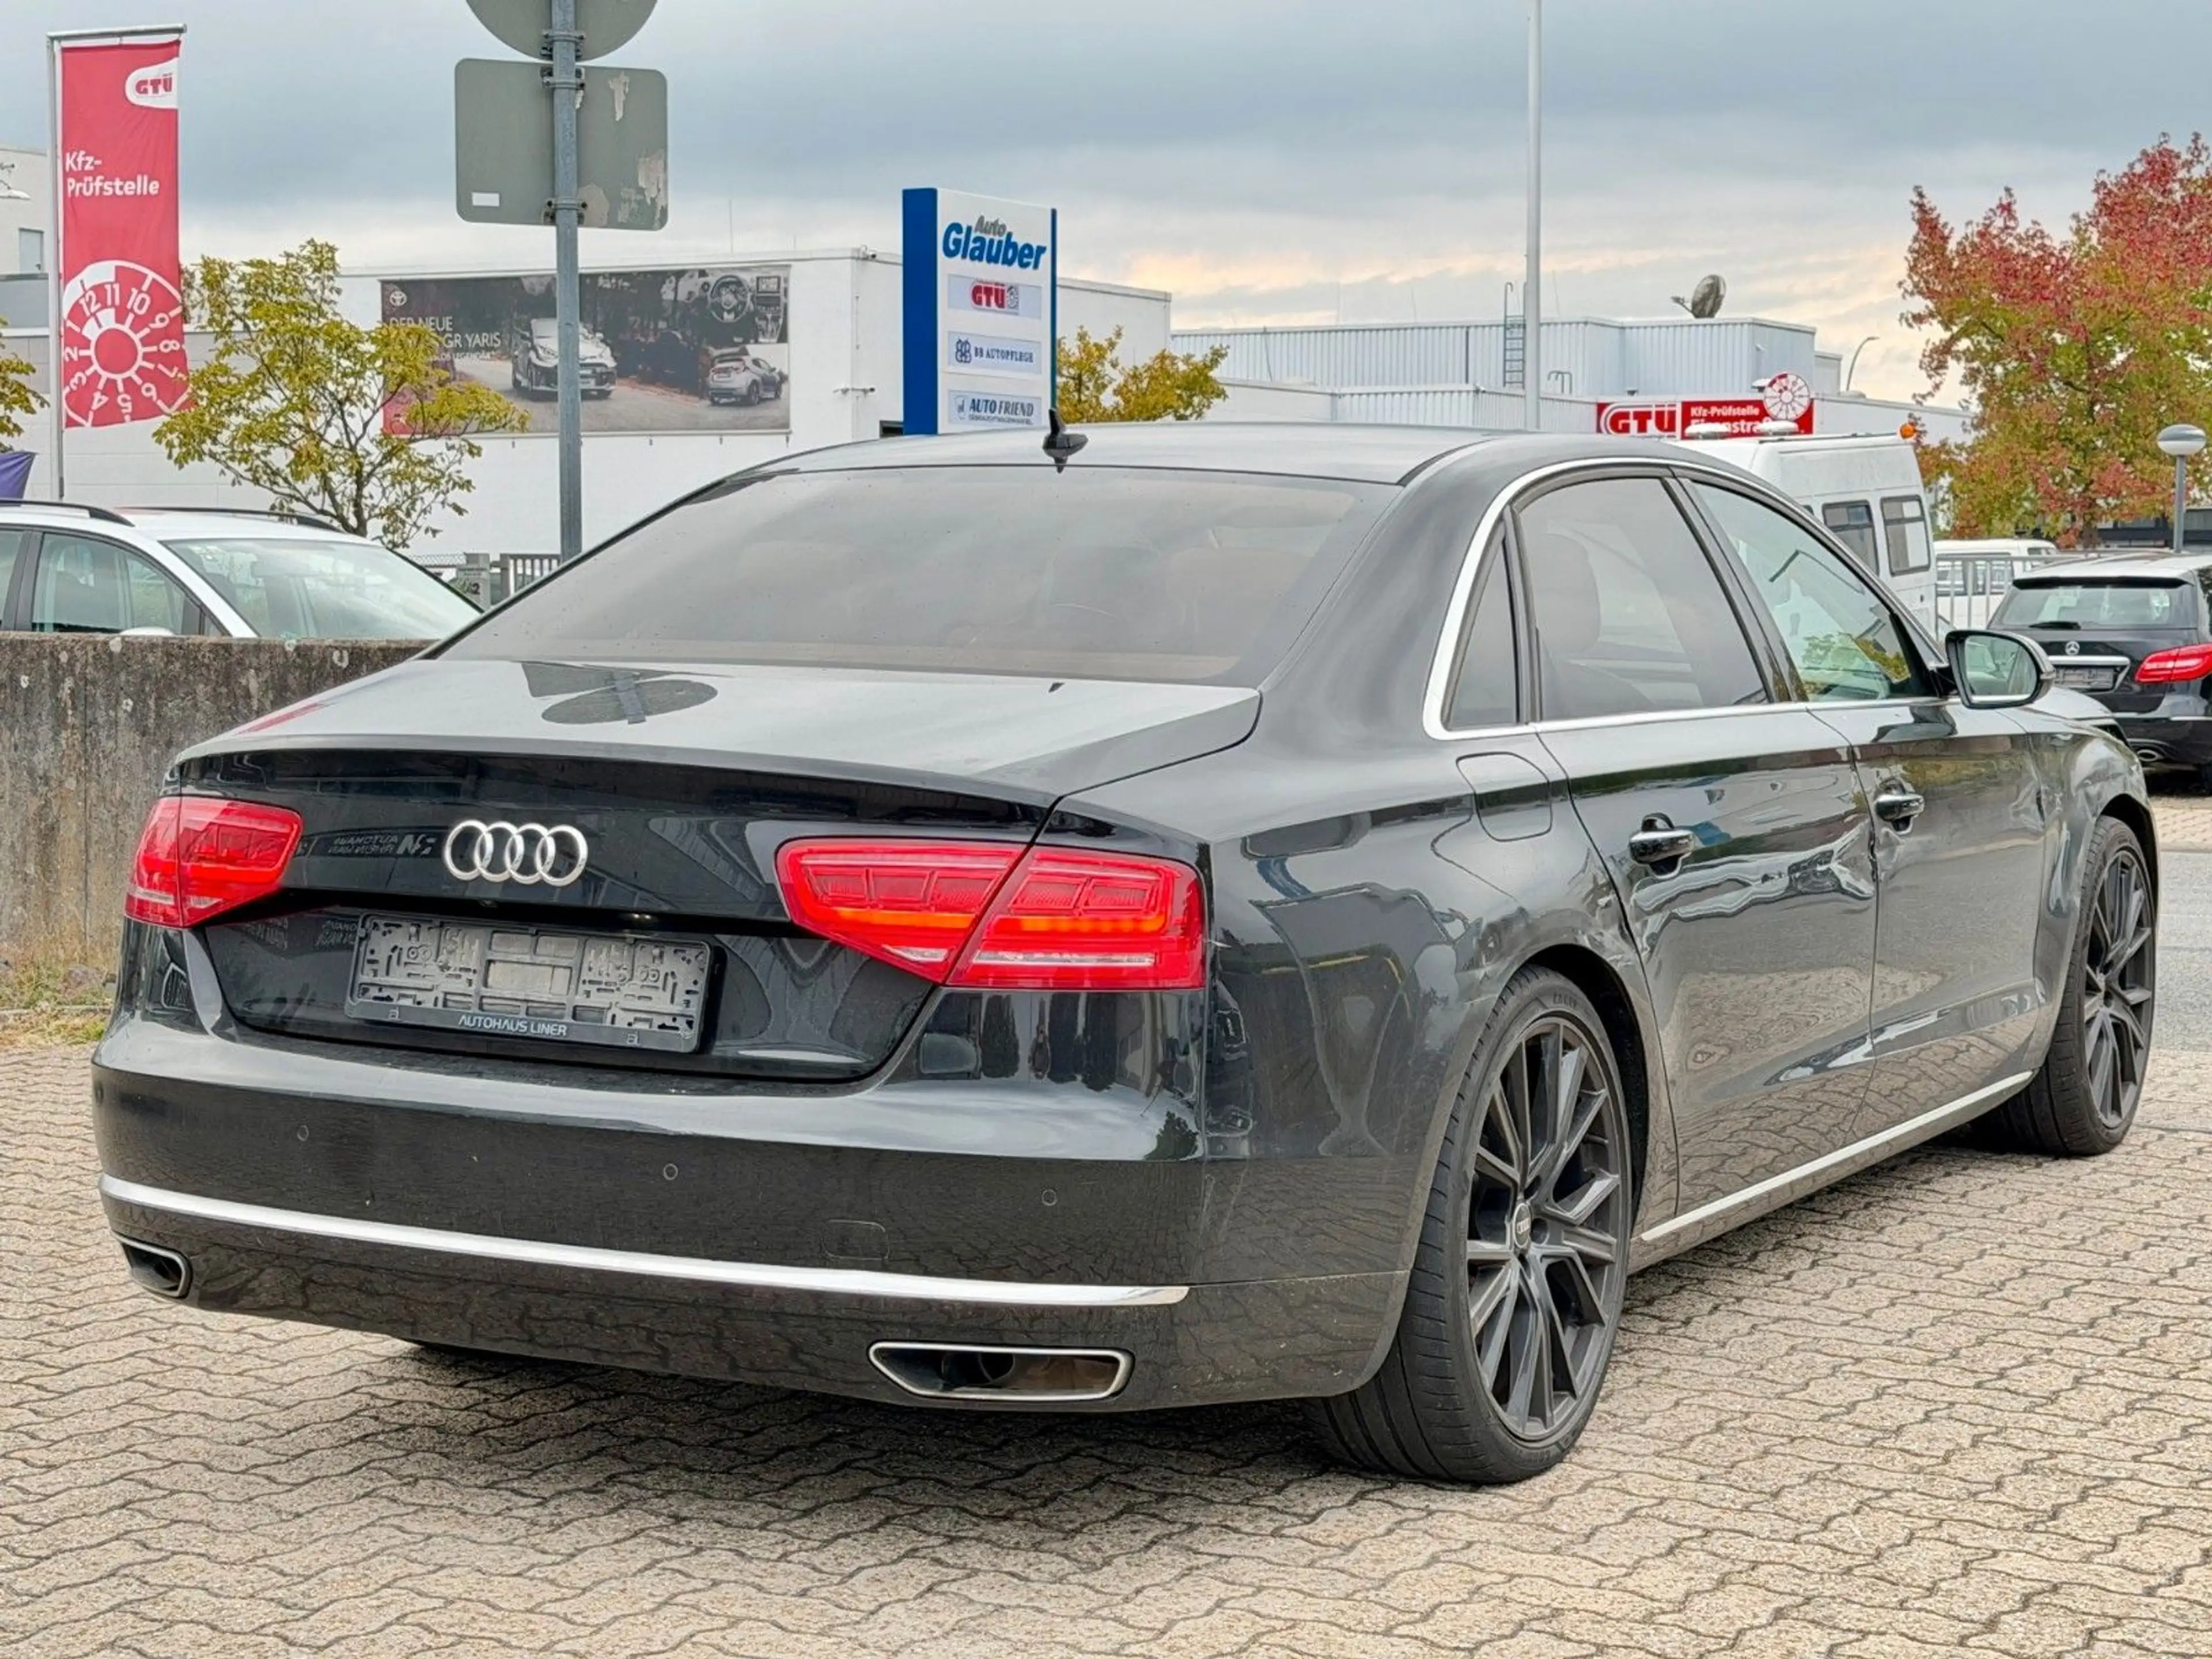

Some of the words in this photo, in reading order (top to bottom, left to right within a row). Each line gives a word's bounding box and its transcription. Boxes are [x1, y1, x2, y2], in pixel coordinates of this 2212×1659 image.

[135, 73, 172, 94] GTÜ
[65, 150, 102, 172] Kfz-
[67, 175, 160, 198] Prüfstelle
[975, 215, 1007, 237] Auto
[942, 222, 1047, 270] Glauber
[79, 290, 101, 316] 12
[104, 283, 120, 306] 11
[127, 287, 151, 316] 10
[418, 316, 453, 331] NEUE
[159, 339, 180, 353] 8
[443, 333, 463, 348] GR
[464, 332, 501, 348] YARIS
[969, 398, 997, 414] AUTO
[998, 400, 1034, 416] FRIEND
[1691, 406, 1760, 417] Kfz-Prüfstelle
[1609, 404, 1676, 433] GTÜ
[459, 1014, 528, 1033] AUTOHAUS
[530, 1021, 567, 1036] LINER
